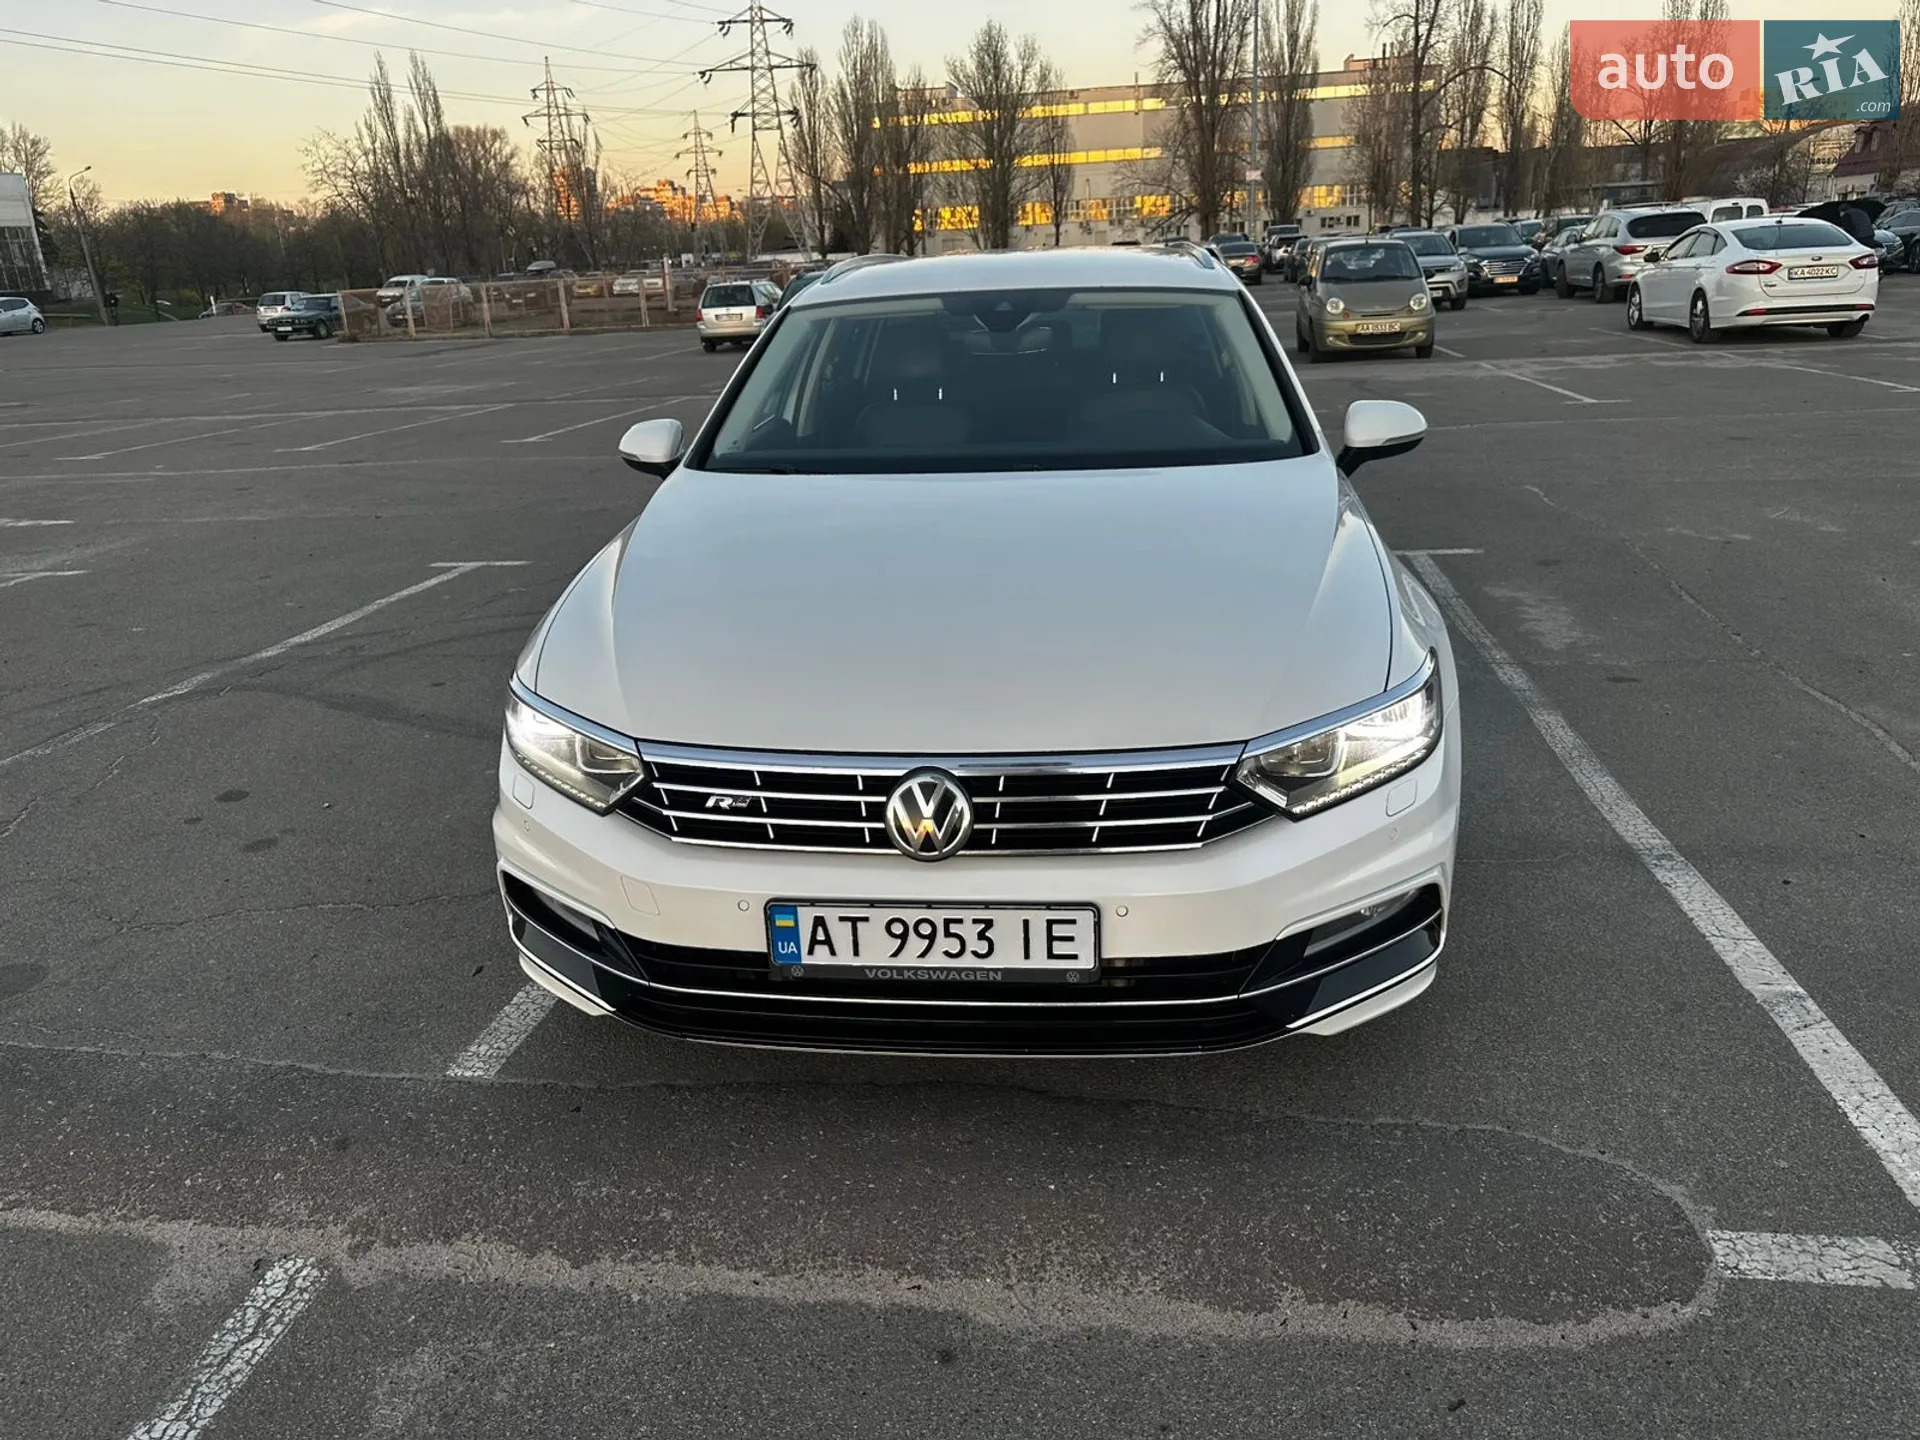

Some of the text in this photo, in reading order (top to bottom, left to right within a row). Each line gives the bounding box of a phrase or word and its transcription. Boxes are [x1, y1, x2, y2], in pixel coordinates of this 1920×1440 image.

[806, 915, 1079, 960] AT 9953 IE
[777, 941, 798, 955] UA
[864, 968, 1003, 982] VOLKSWAGEN
